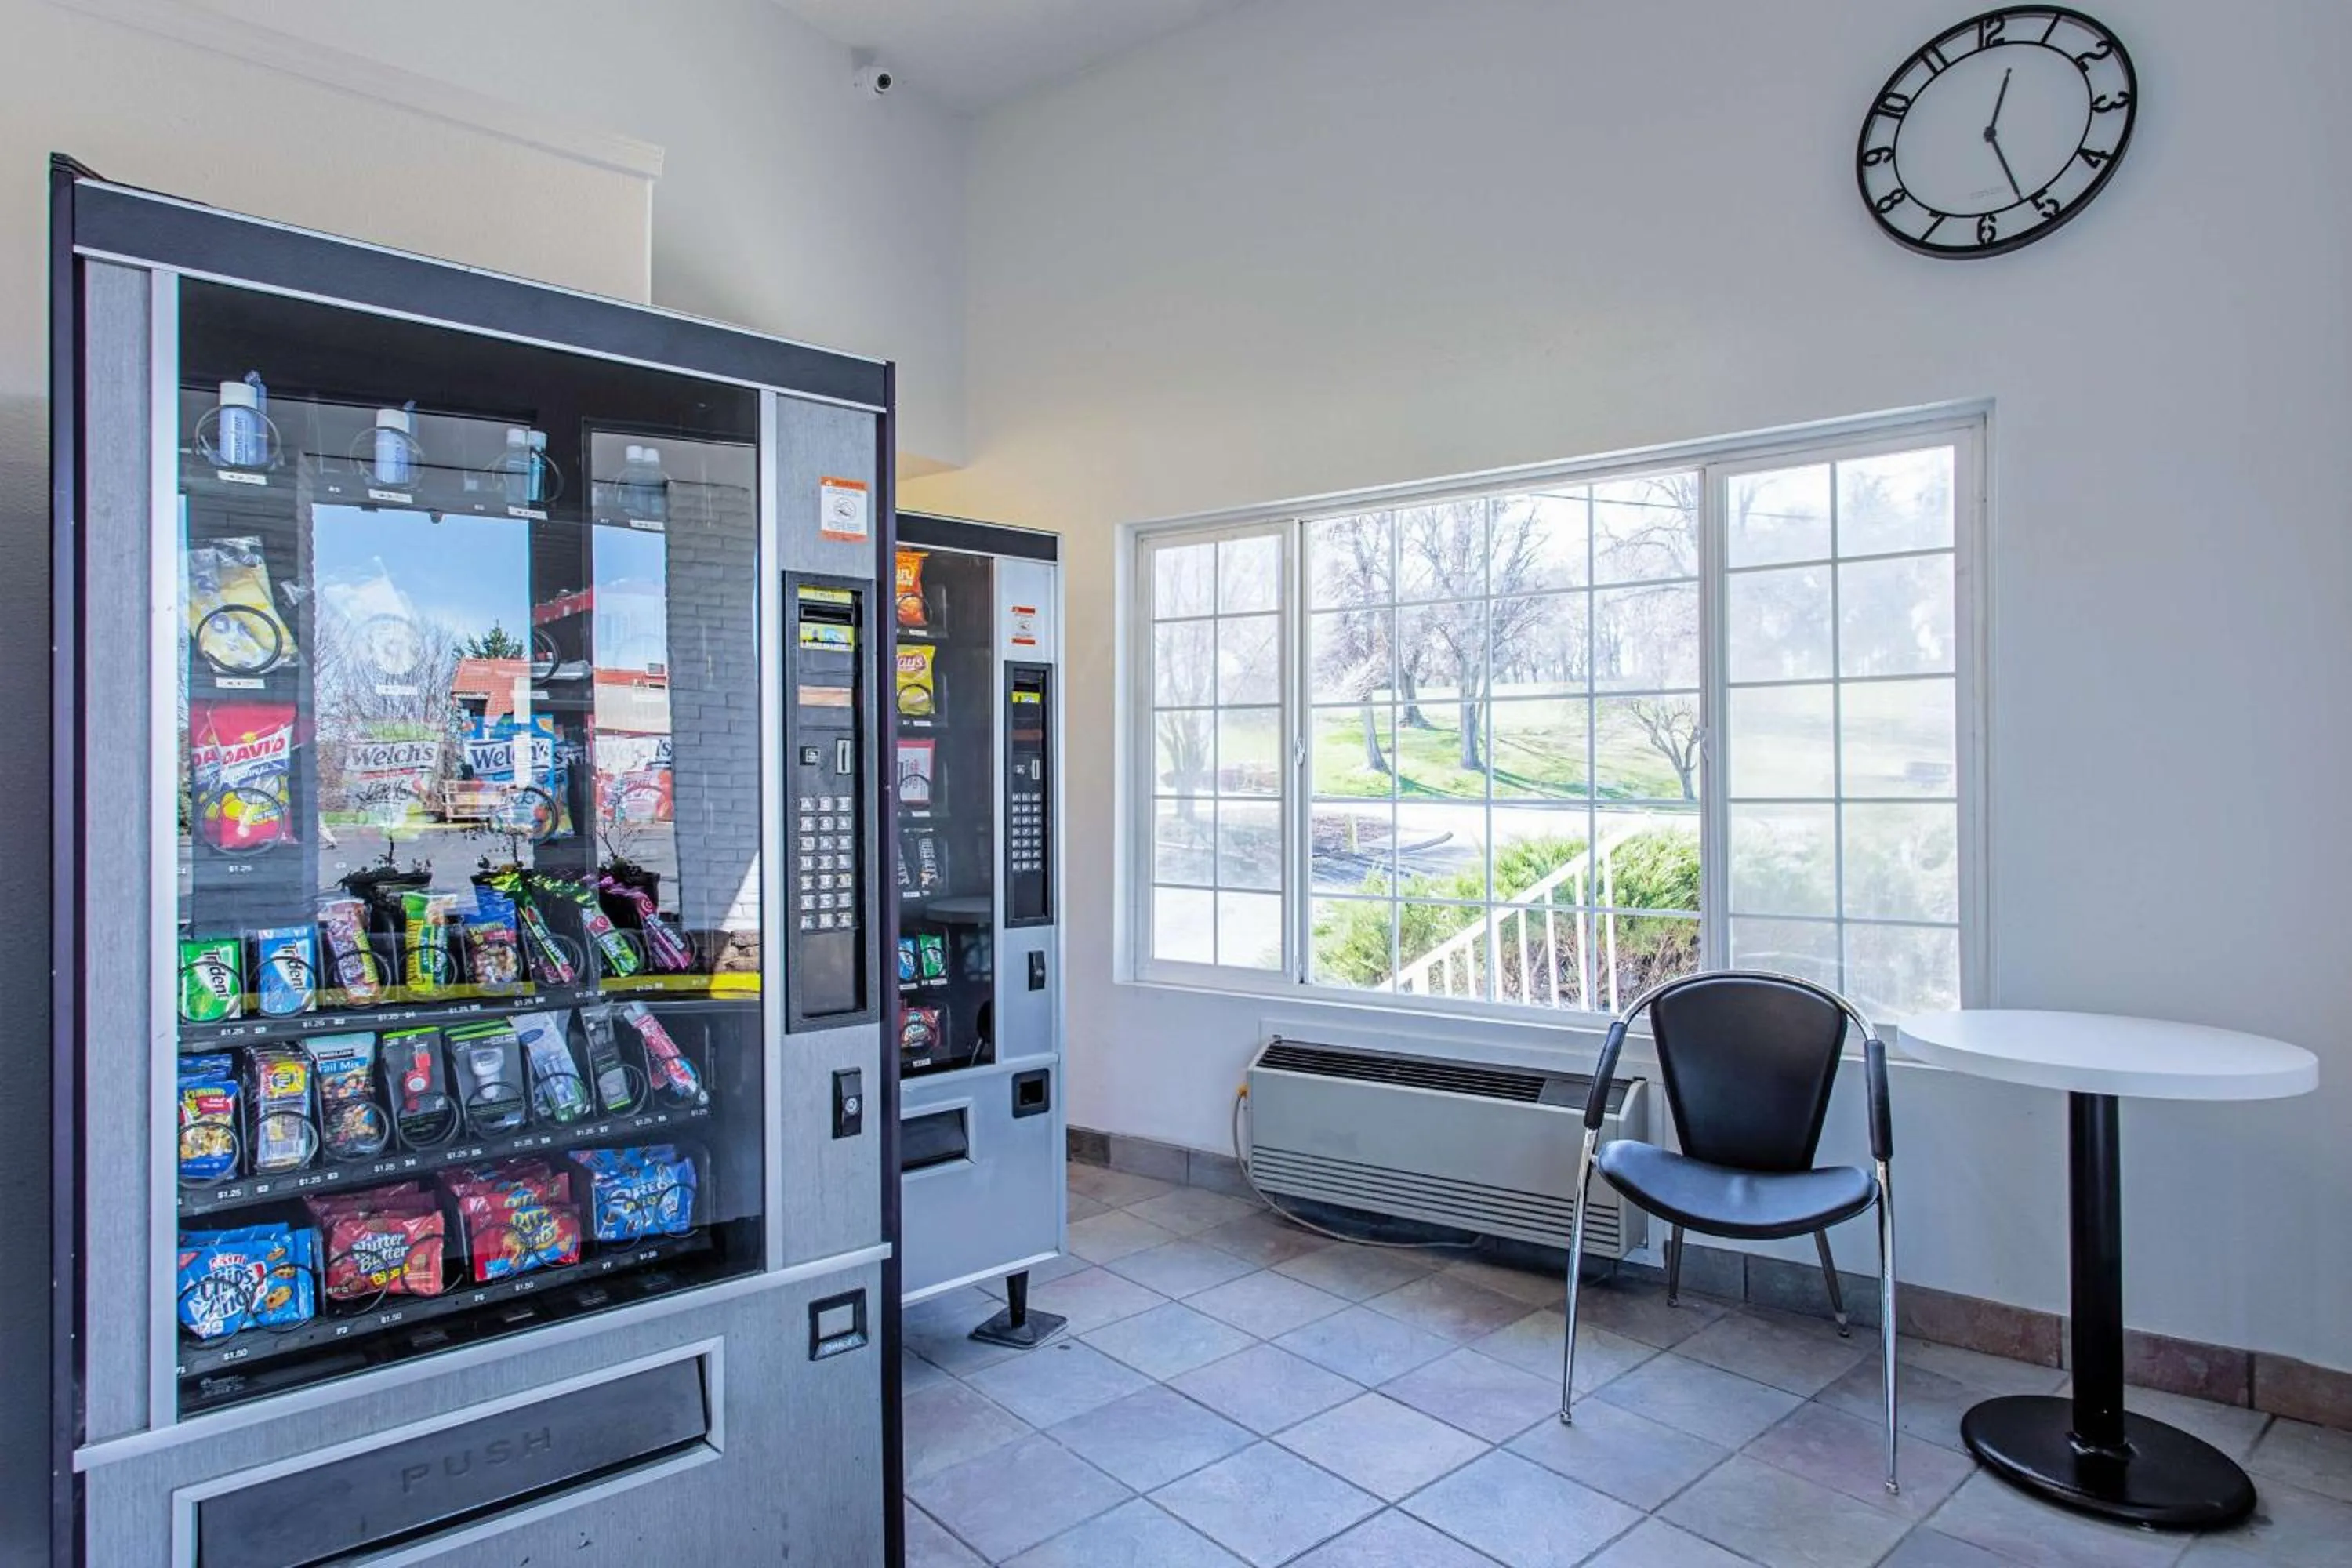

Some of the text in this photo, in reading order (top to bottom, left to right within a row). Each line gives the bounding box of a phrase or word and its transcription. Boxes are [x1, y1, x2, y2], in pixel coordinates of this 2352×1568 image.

[1976, 14, 2006, 49] 12
[2038, 13, 2061, 45] 1
[1919, 42, 1951, 75] 11
[2076, 39, 2114, 73] 2
[1875, 91, 1911, 120] 10
[2090, 90, 2131, 114] 3
[1860, 145, 1896, 168] 9
[2078, 147, 2114, 169] 4
[1875, 187, 1907, 215] 8
[2031, 187, 2061, 220] 5
[1919, 209, 1947, 242] 7
[1976, 213, 1998, 245] 6
[897, 654, 925, 671] ay's
[223, 736, 285, 765] DAVID
[350, 742, 434, 767] Welch's
[200, 946, 230, 1000] Trdent
[279, 941, 307, 991] Trdent
[220, 1025, 245, 1036] $1.25
[319, 1061, 337, 1074] rail
[299, 1176, 322, 1186] $1.25
[374, 1163, 396, 1173] $1.25
[217, 1189, 242, 1199] $1.25
[353, 1233, 406, 1253] Nutter
[401, 1425, 551, 1493] PUSH
